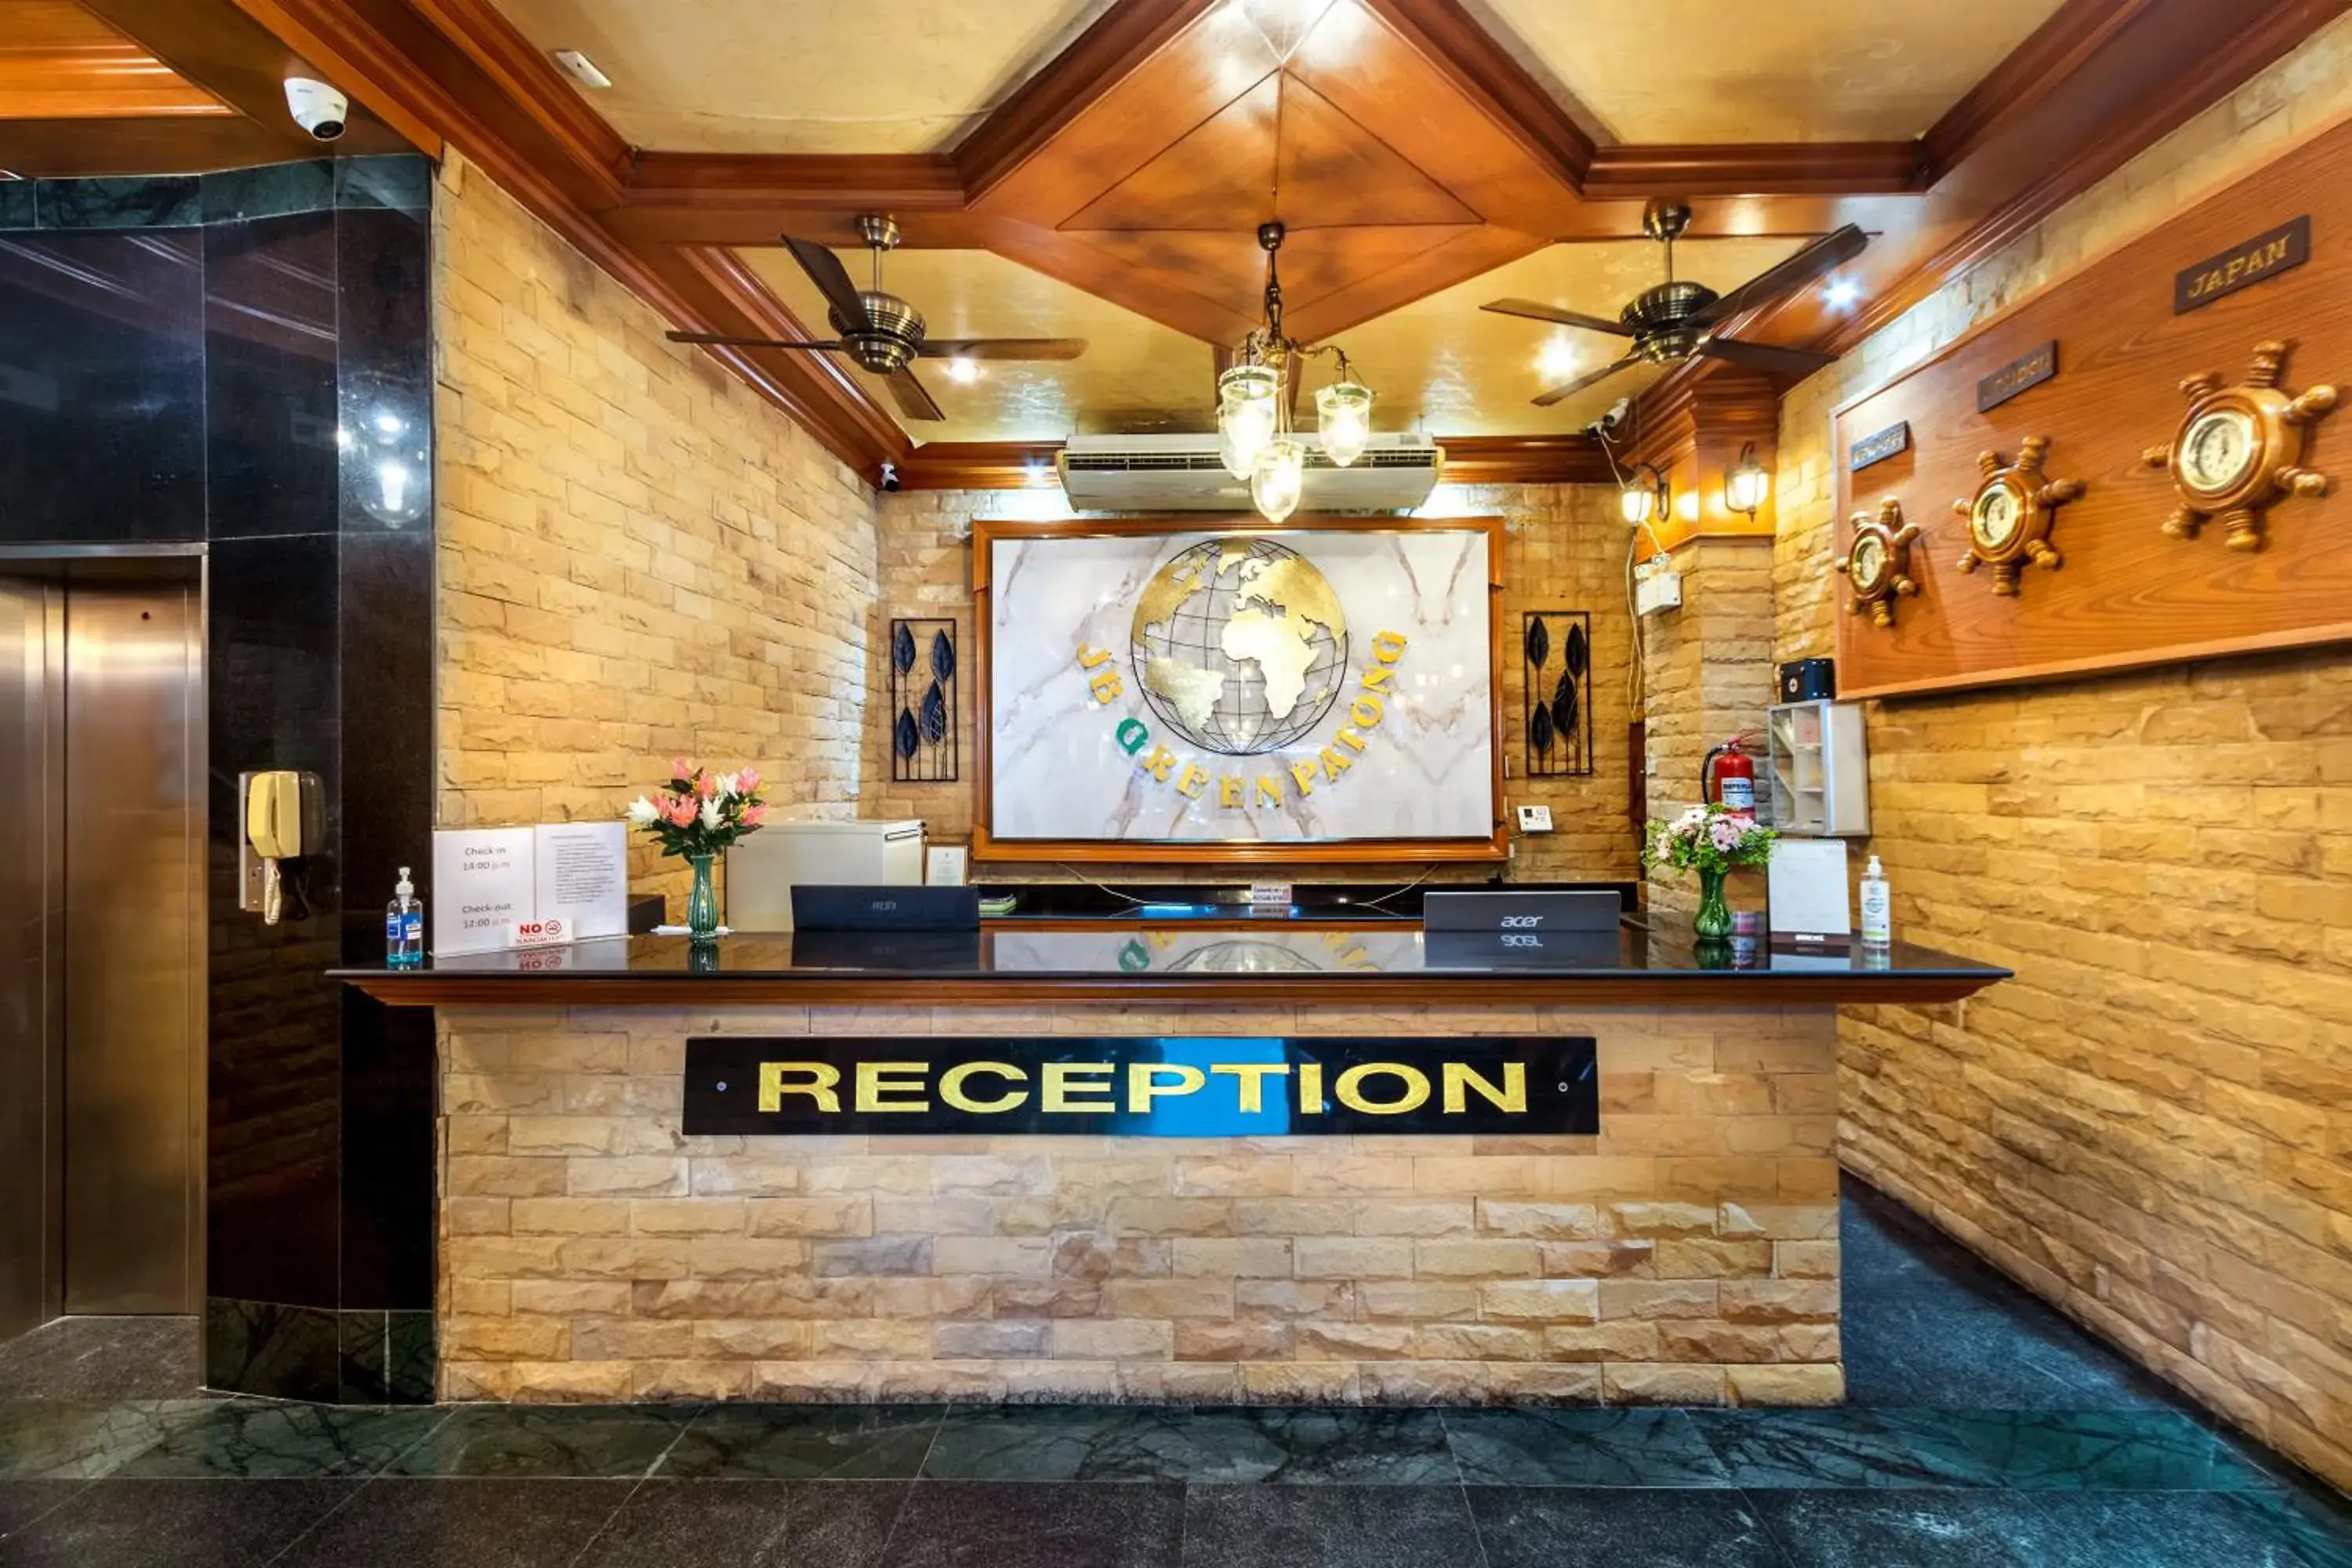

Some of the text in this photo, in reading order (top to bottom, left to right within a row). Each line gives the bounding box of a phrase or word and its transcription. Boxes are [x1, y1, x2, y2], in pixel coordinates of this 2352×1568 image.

[2187, 234, 2292, 299] JAPAN
[1077, 642, 1124, 704] JB
[520, 924, 542, 934] NO
[1501, 916, 1544, 927] acer
[758, 1062, 1527, 1113] RECEPTION
